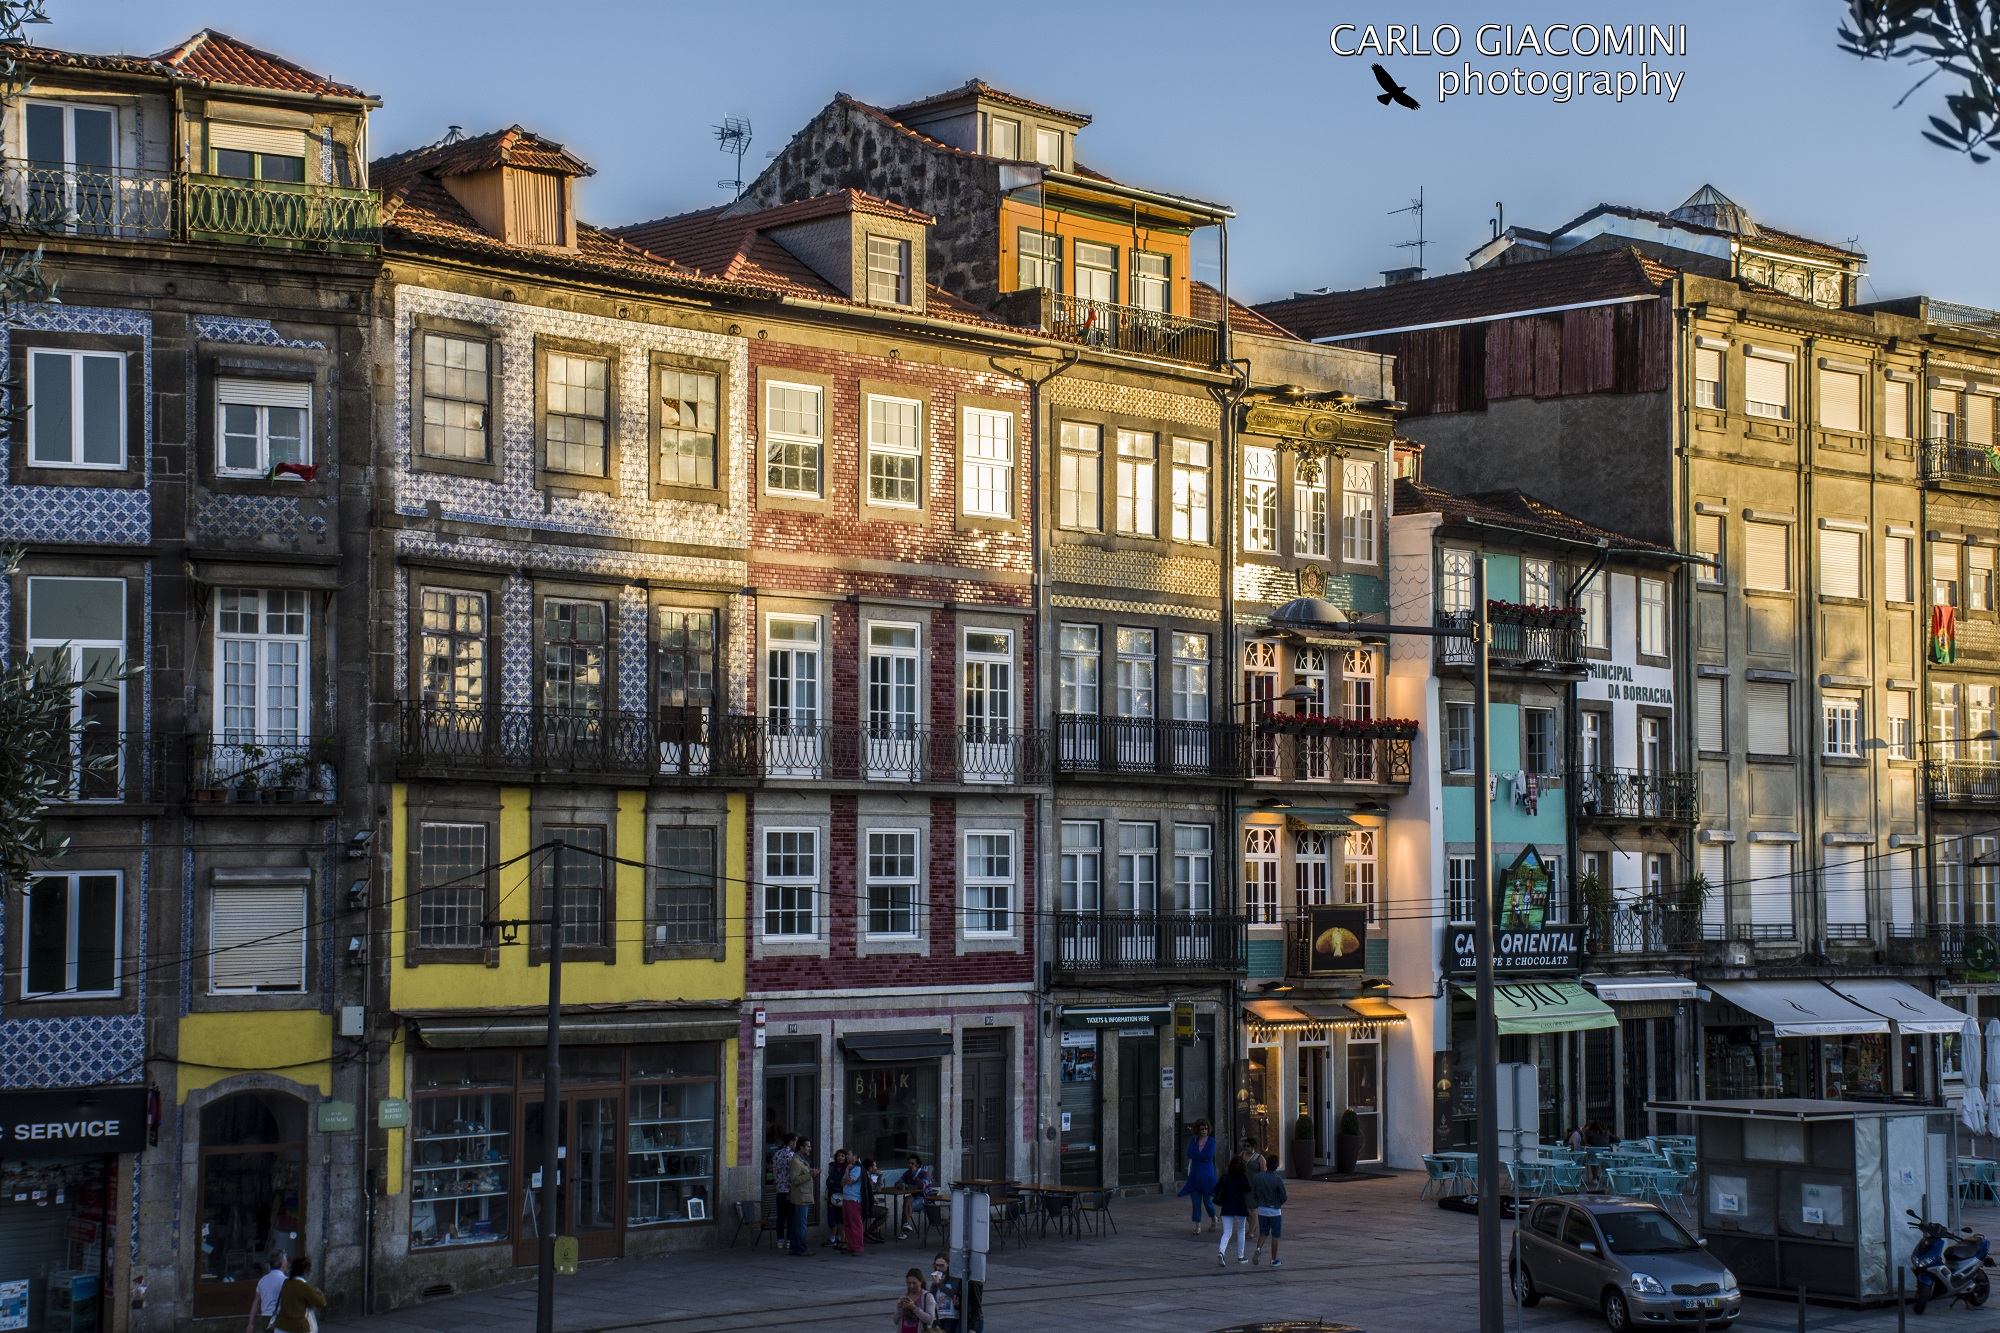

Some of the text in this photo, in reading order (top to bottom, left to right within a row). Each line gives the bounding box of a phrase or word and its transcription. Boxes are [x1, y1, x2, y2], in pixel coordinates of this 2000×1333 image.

[1587, 663, 1634, 682] RINCIPAL
[1608, 684, 1673, 704] DA BORRACHA
[1500, 933, 1578, 954] ORIENTAL
[1506, 957, 1513, 966] E
[1515, 956, 1569, 966] CHOCOLATE
[1620, 1003, 1672, 1017] DA BORRACHA
[14, 1119, 120, 1140] SERVICE
